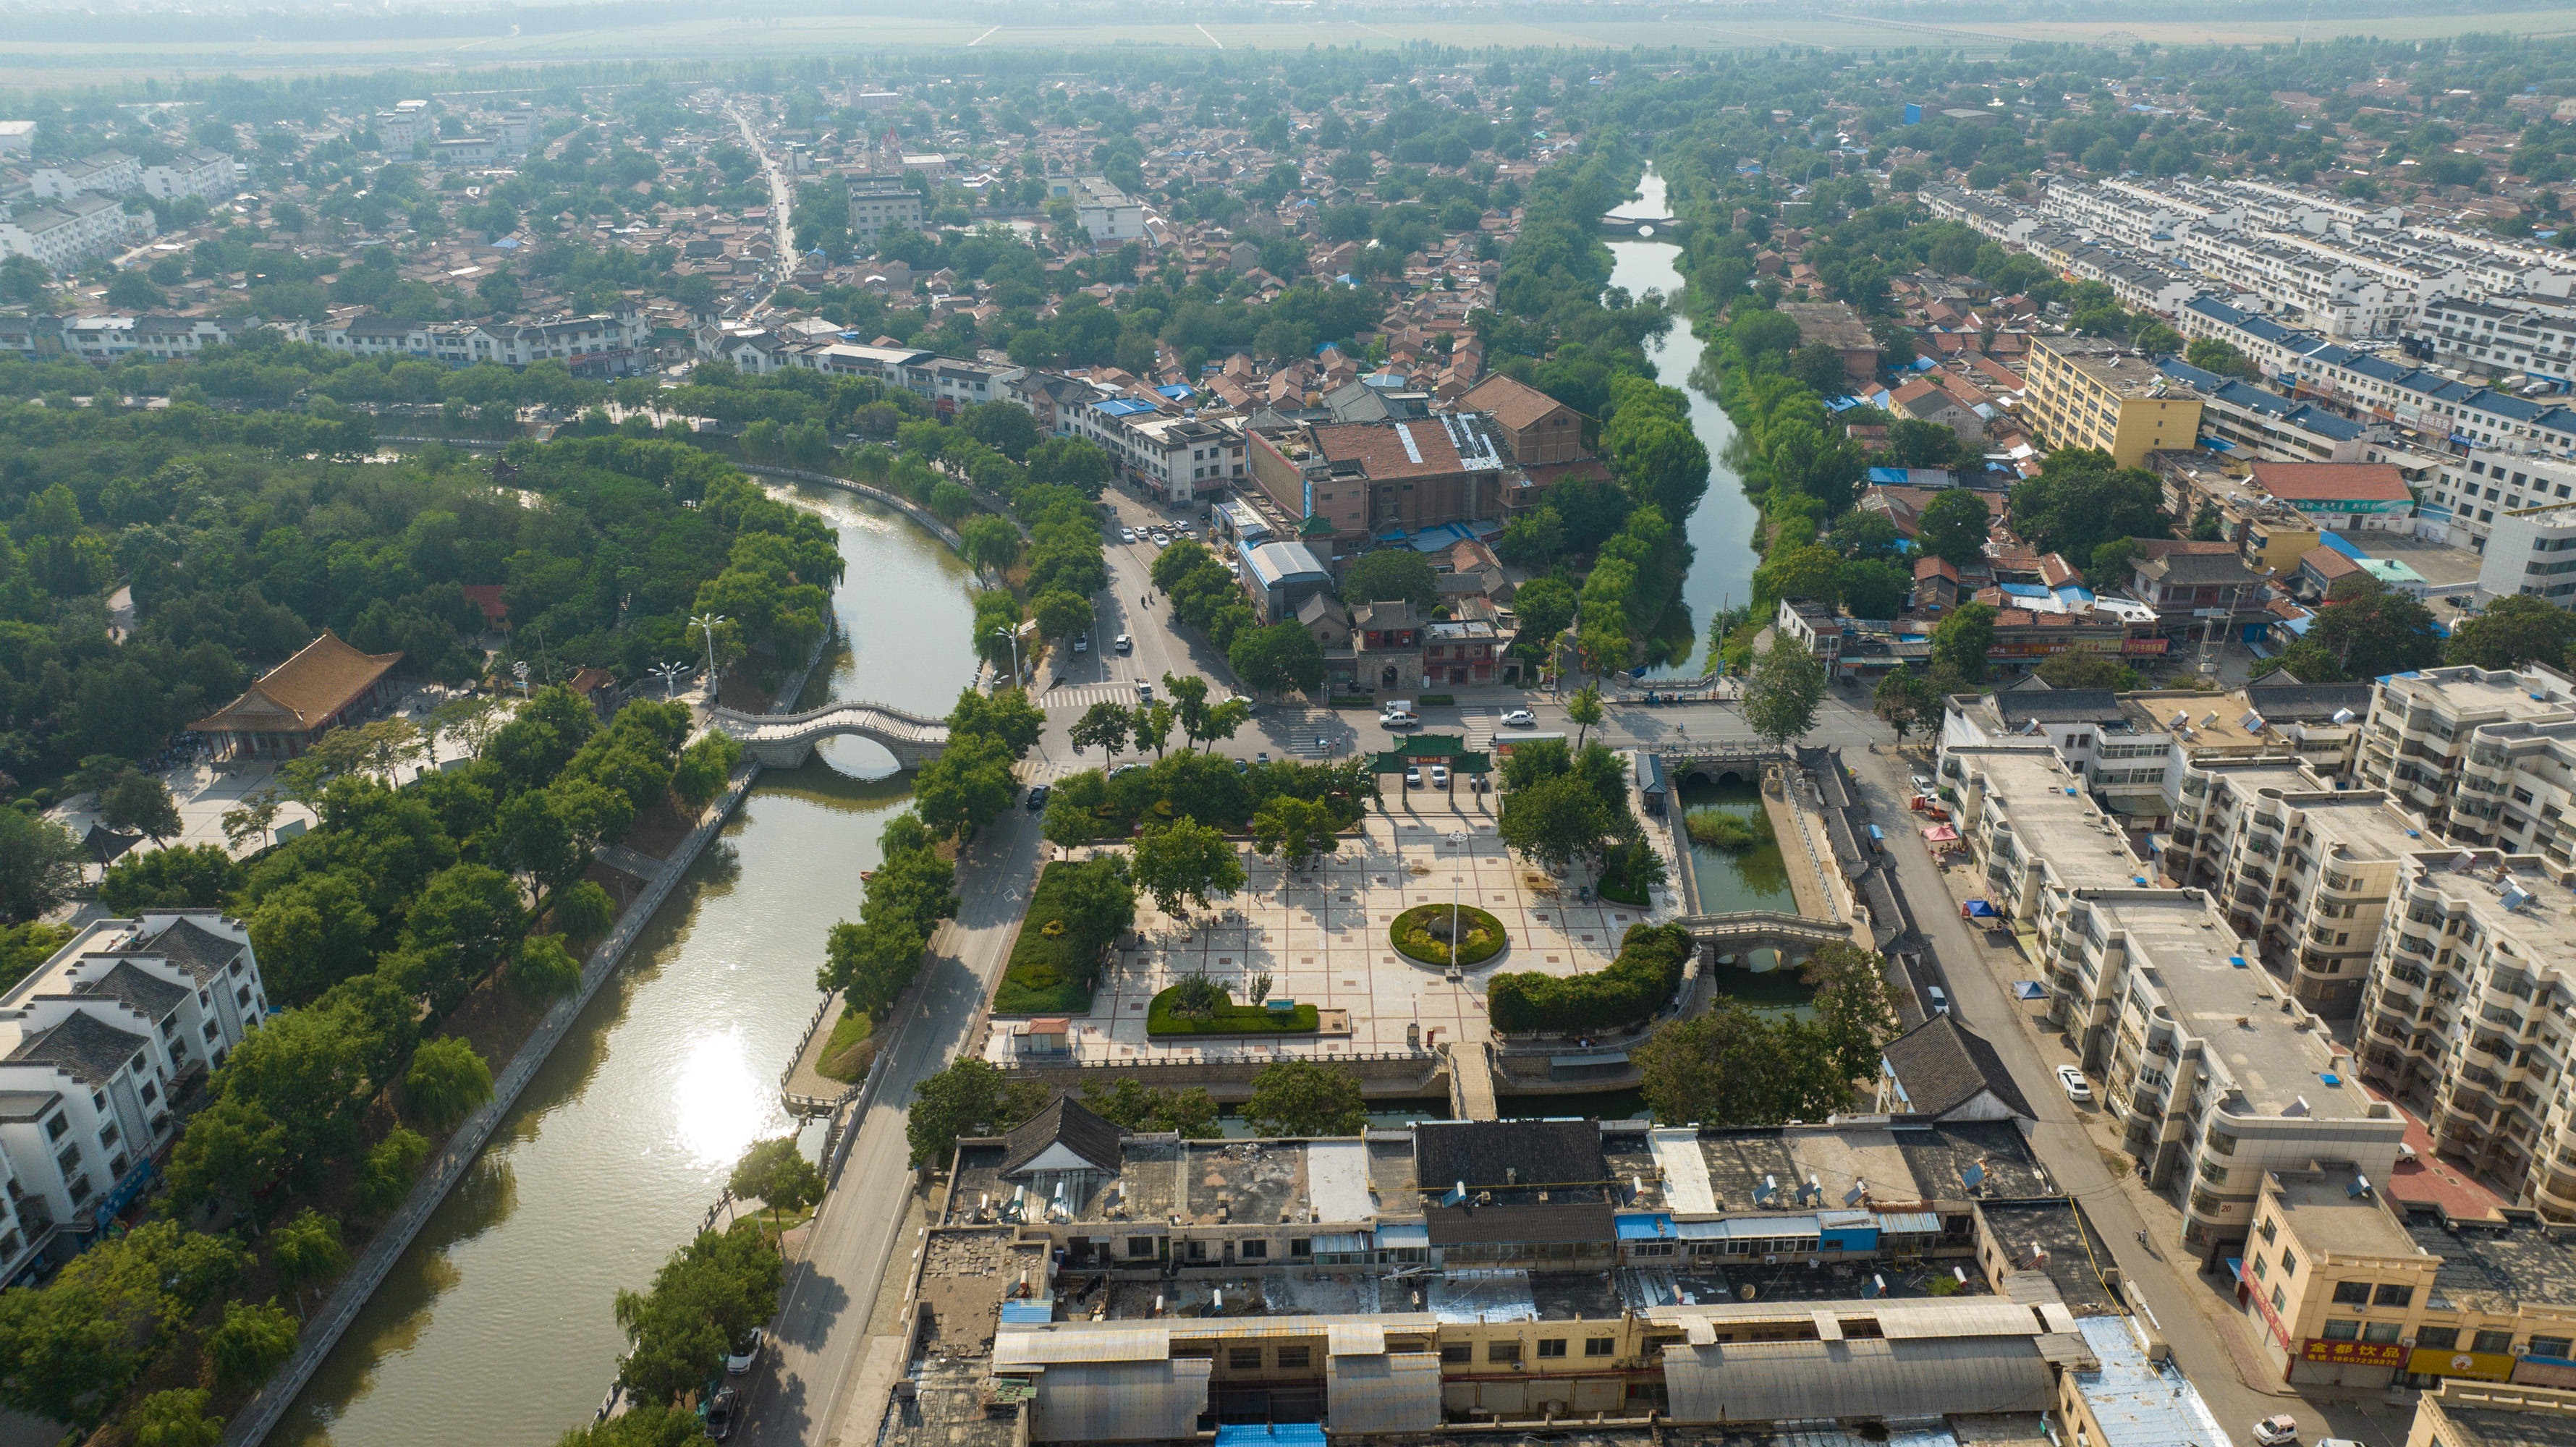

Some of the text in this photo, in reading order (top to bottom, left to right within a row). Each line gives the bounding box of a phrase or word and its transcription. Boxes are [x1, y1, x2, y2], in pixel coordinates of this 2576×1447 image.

[2420, 413, 2450, 430] 宏达百货
[2310, 1342, 2399, 1359] 金都饮品
